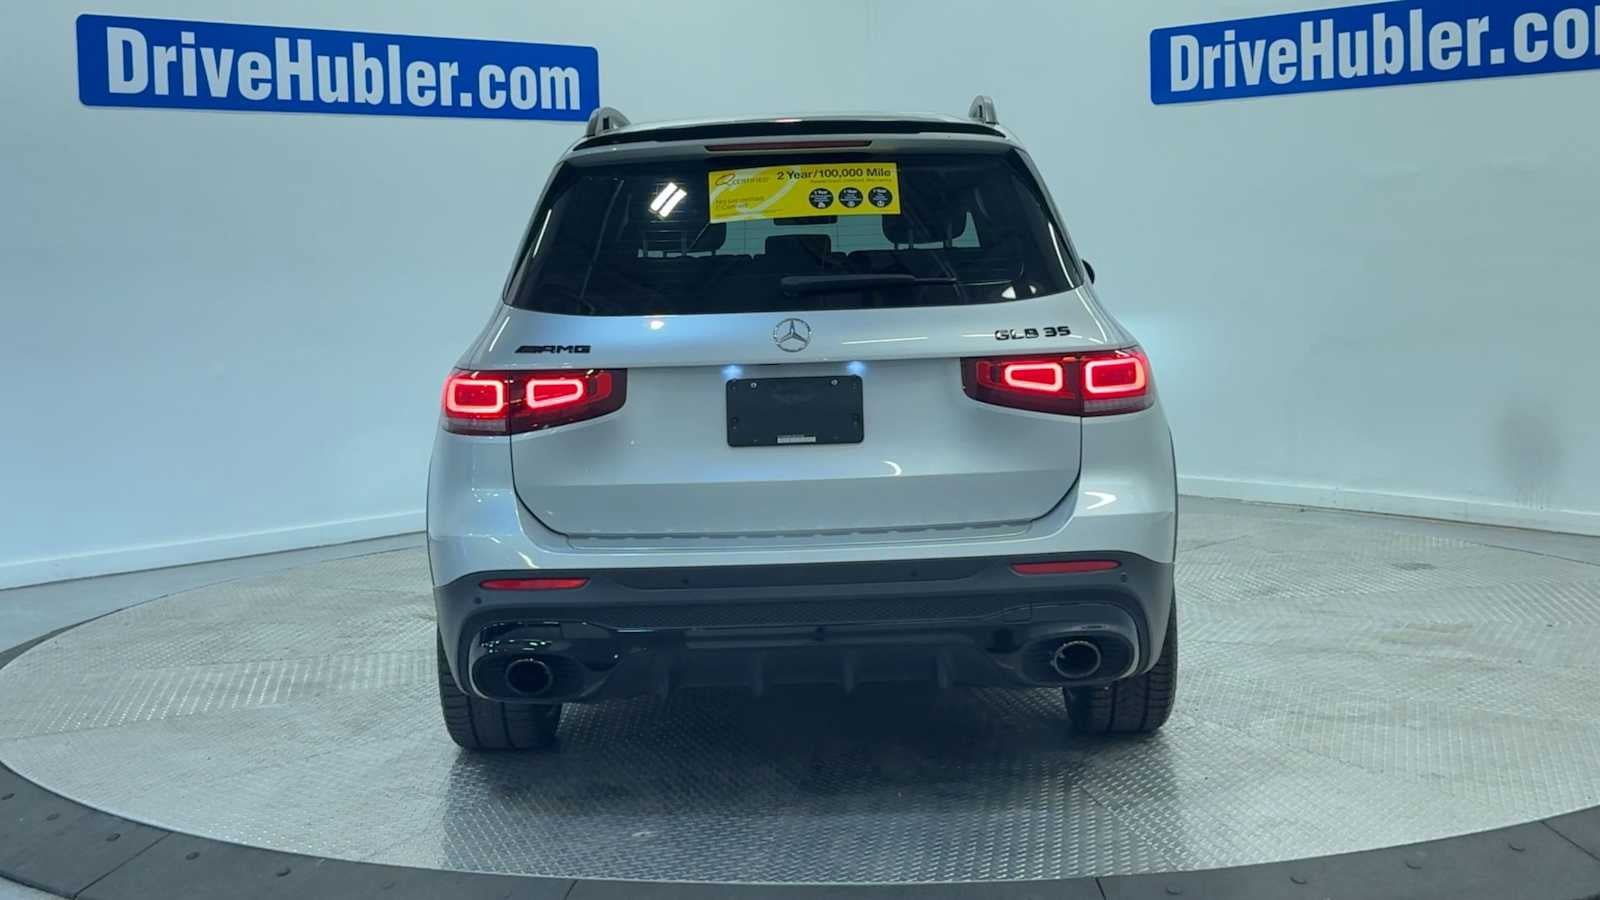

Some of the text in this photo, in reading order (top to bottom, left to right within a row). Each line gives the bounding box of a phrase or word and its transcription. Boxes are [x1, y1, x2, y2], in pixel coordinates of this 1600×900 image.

[106, 26, 581, 111] DriveHubler.com
[1169, 4, 1600, 93] DriveHubler.co
[776, 167, 891, 180] 2 Year/100,000 Mile
[994, 325, 1072, 341] GLB 35
